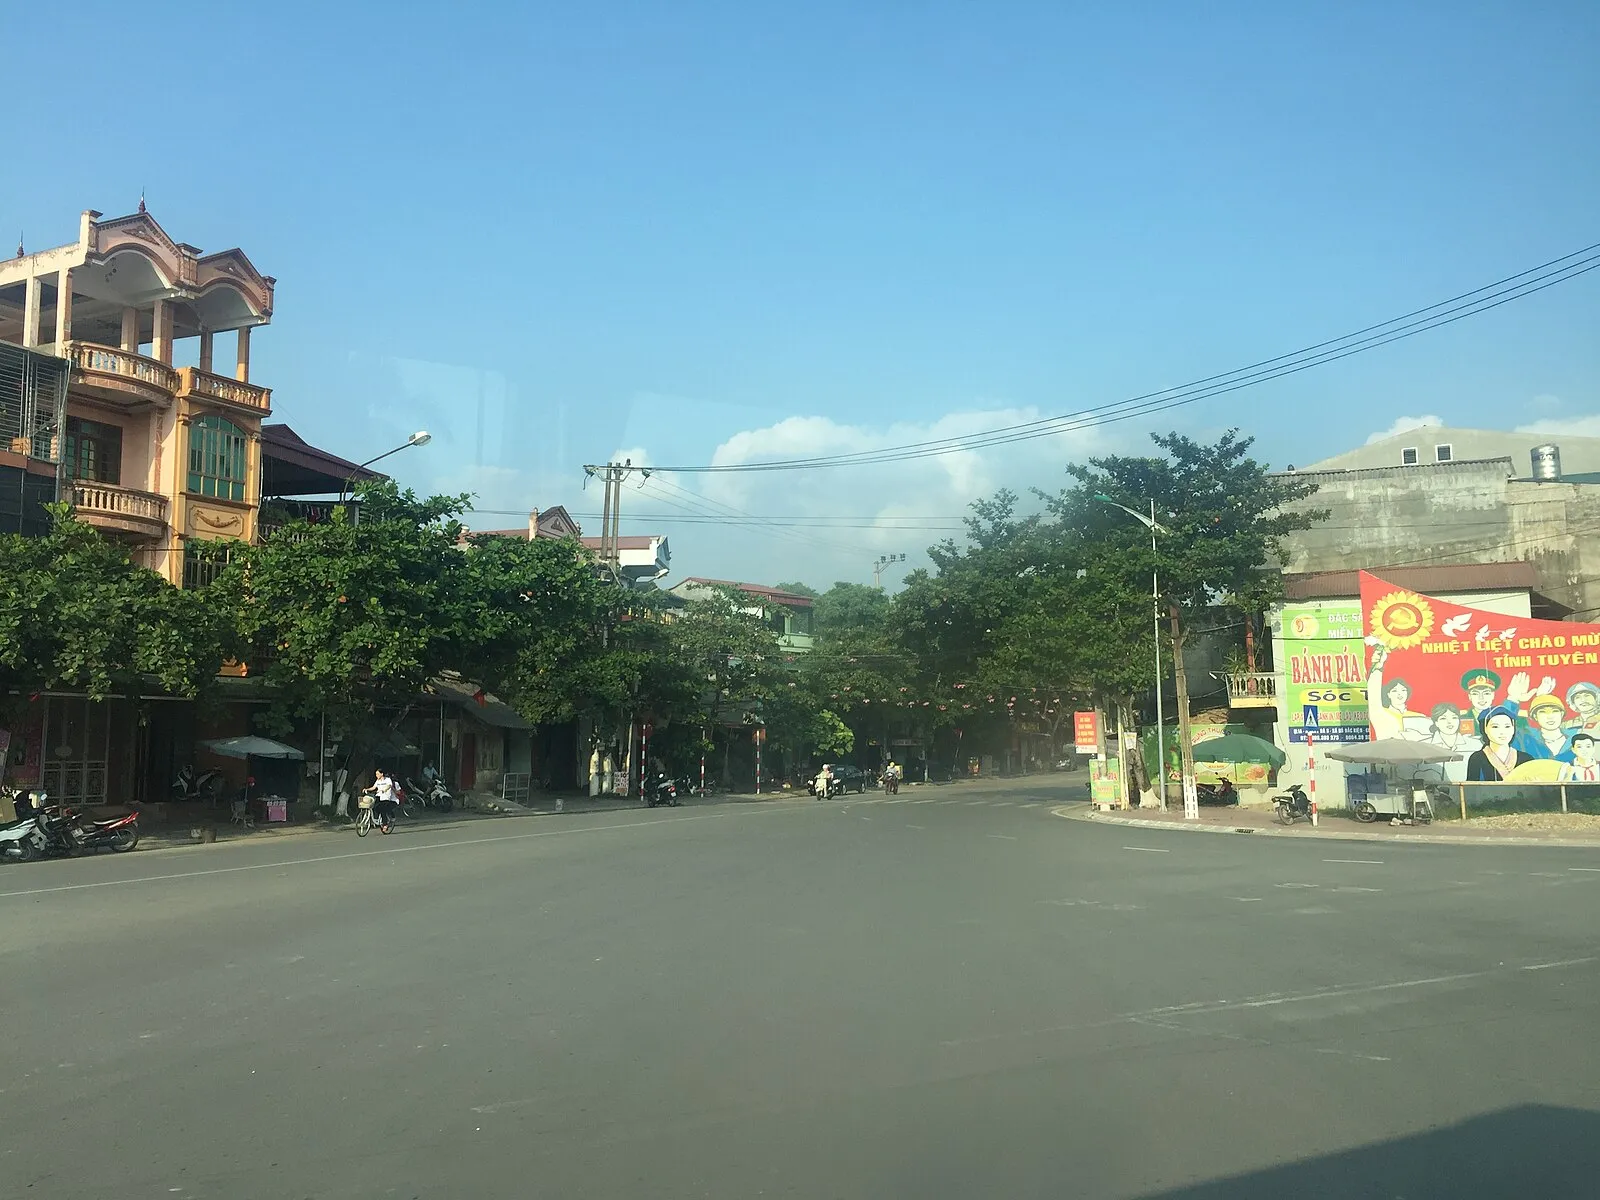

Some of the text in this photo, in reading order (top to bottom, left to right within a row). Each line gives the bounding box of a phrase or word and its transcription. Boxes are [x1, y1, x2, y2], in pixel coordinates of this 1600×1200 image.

[1422, 640, 1471, 655] NHIỆT
[1476, 638, 1513, 653] LIỆT
[1519, 635, 1566, 649] CHÀO
[1291, 645, 1362, 684] BÁNH PÍA
[1493, 650, 1598, 668] TỈNH TUYÊN
